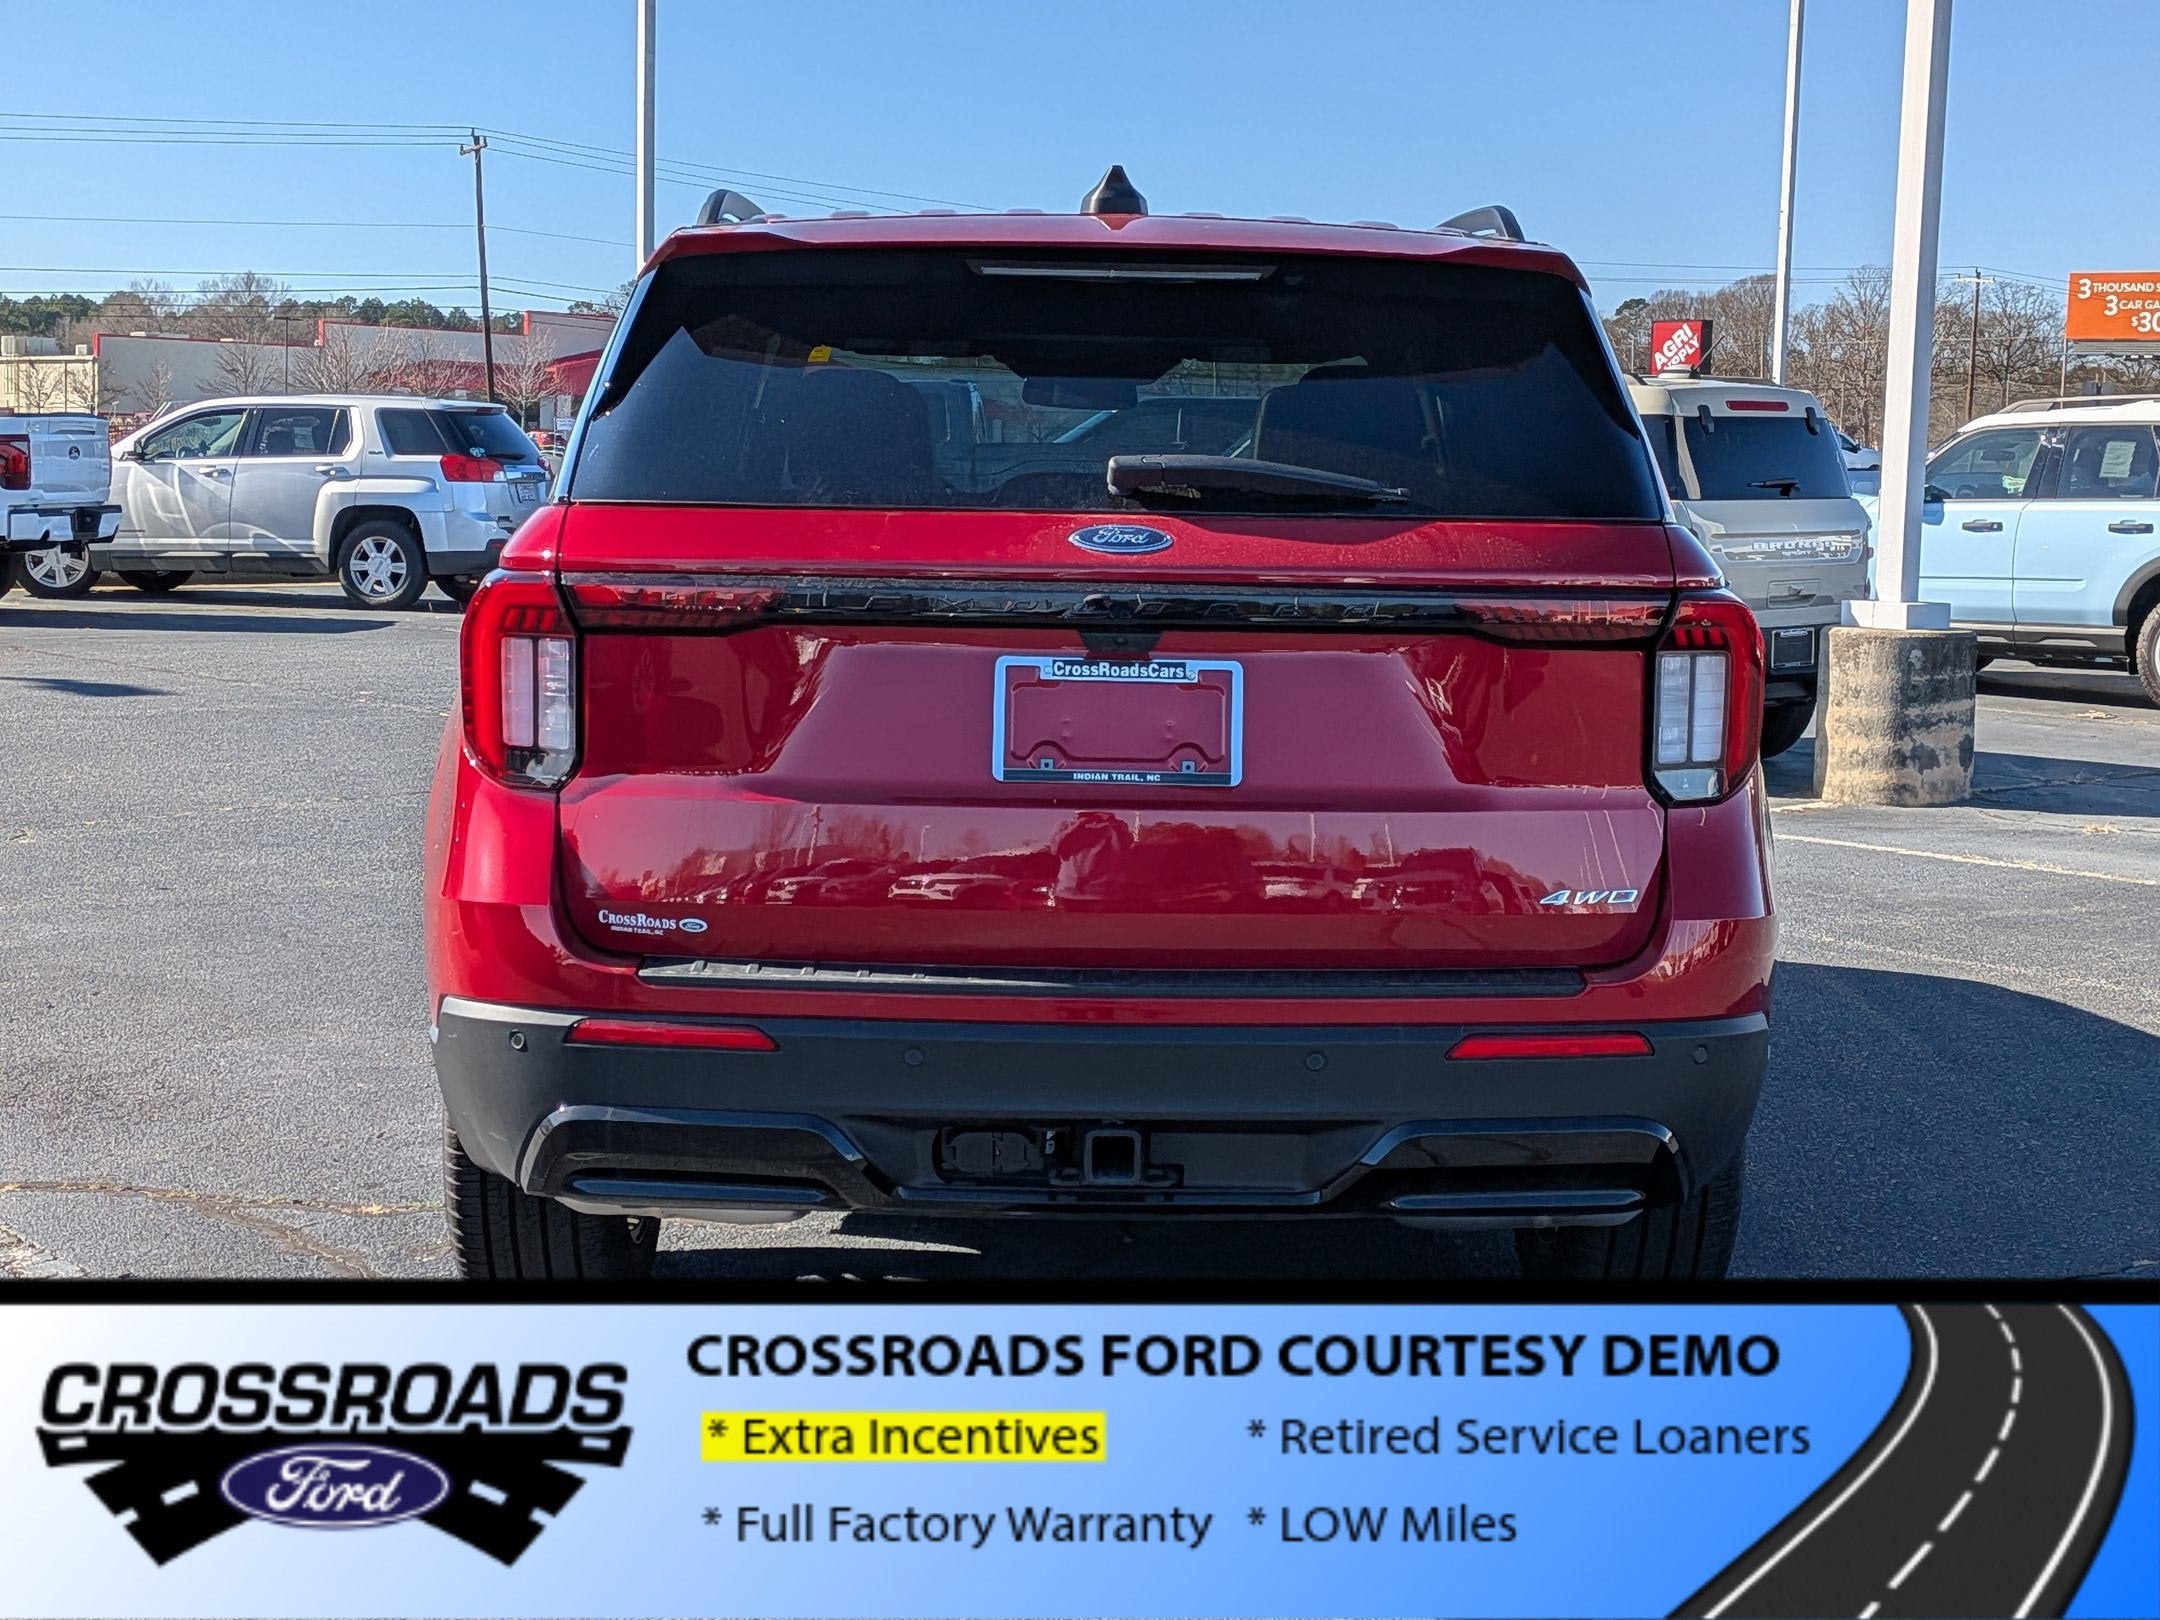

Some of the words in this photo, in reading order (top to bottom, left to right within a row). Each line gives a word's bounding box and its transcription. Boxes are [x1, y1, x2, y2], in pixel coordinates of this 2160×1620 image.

[2078, 278, 2091, 299] 3
[2092, 282, 2154, 293] THOUSAND
[2104, 295, 2118, 316] 3
[2119, 300, 2142, 309] CAR
[1654, 323, 1693, 371] AGRI
[1093, 526, 1150, 543] Ford
[1053, 661, 1185, 679] CrossRoadsCars
[1073, 772, 1109, 781] INDIAN
[1112, 772, 1144, 782] TRAIL,
[1147, 773, 1161, 782] NC
[1540, 889, 1638, 905] 4WD
